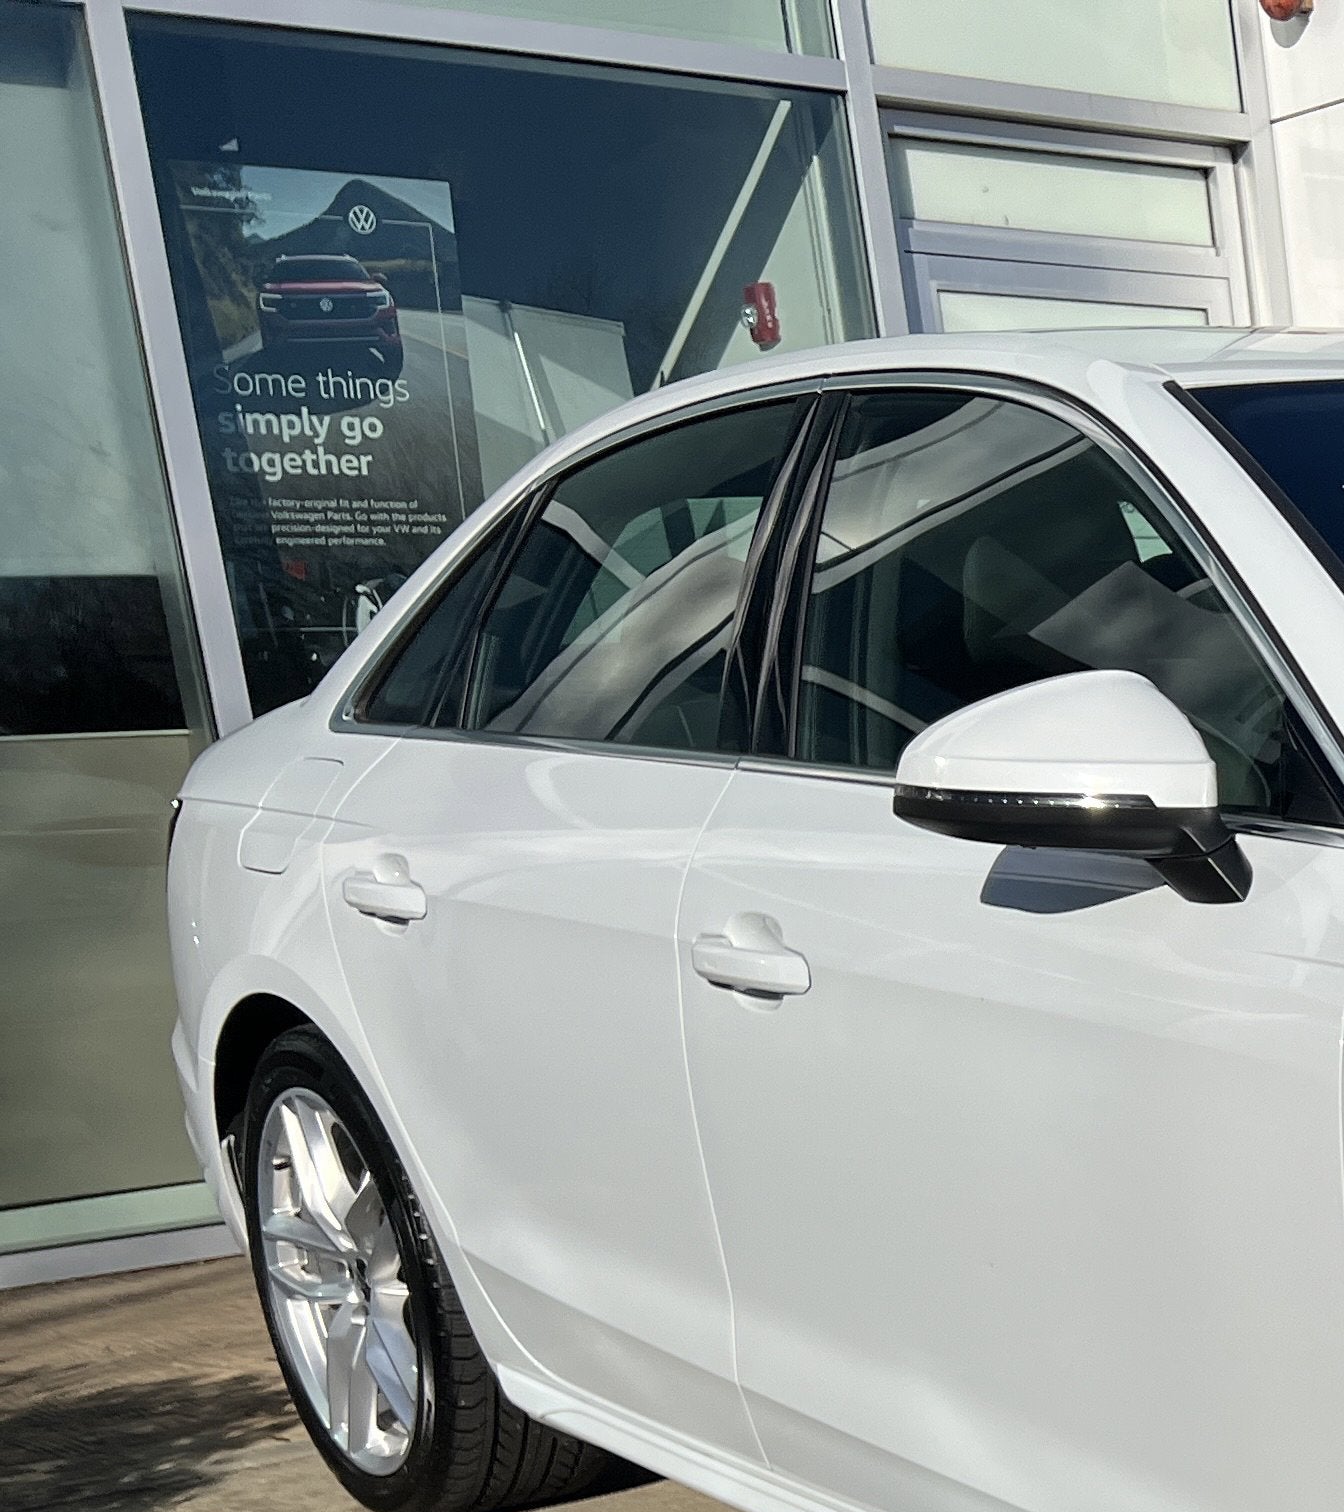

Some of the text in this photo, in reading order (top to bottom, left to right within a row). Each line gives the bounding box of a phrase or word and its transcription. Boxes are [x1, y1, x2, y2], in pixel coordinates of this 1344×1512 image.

[213, 364, 410, 408] Some things
[218, 403, 384, 446] simply go
[222, 446, 373, 482] together
[352, 499, 368, 508] and
[271, 510, 325, 522] Volkswagen
[355, 511, 368, 521] Go
[370, 511, 389, 521] with
[391, 512, 406, 521] the
[408, 513, 447, 523] products
[371, 525, 391, 535] your
[393, 524, 410, 533] VW
[412, 525, 428, 534] and
